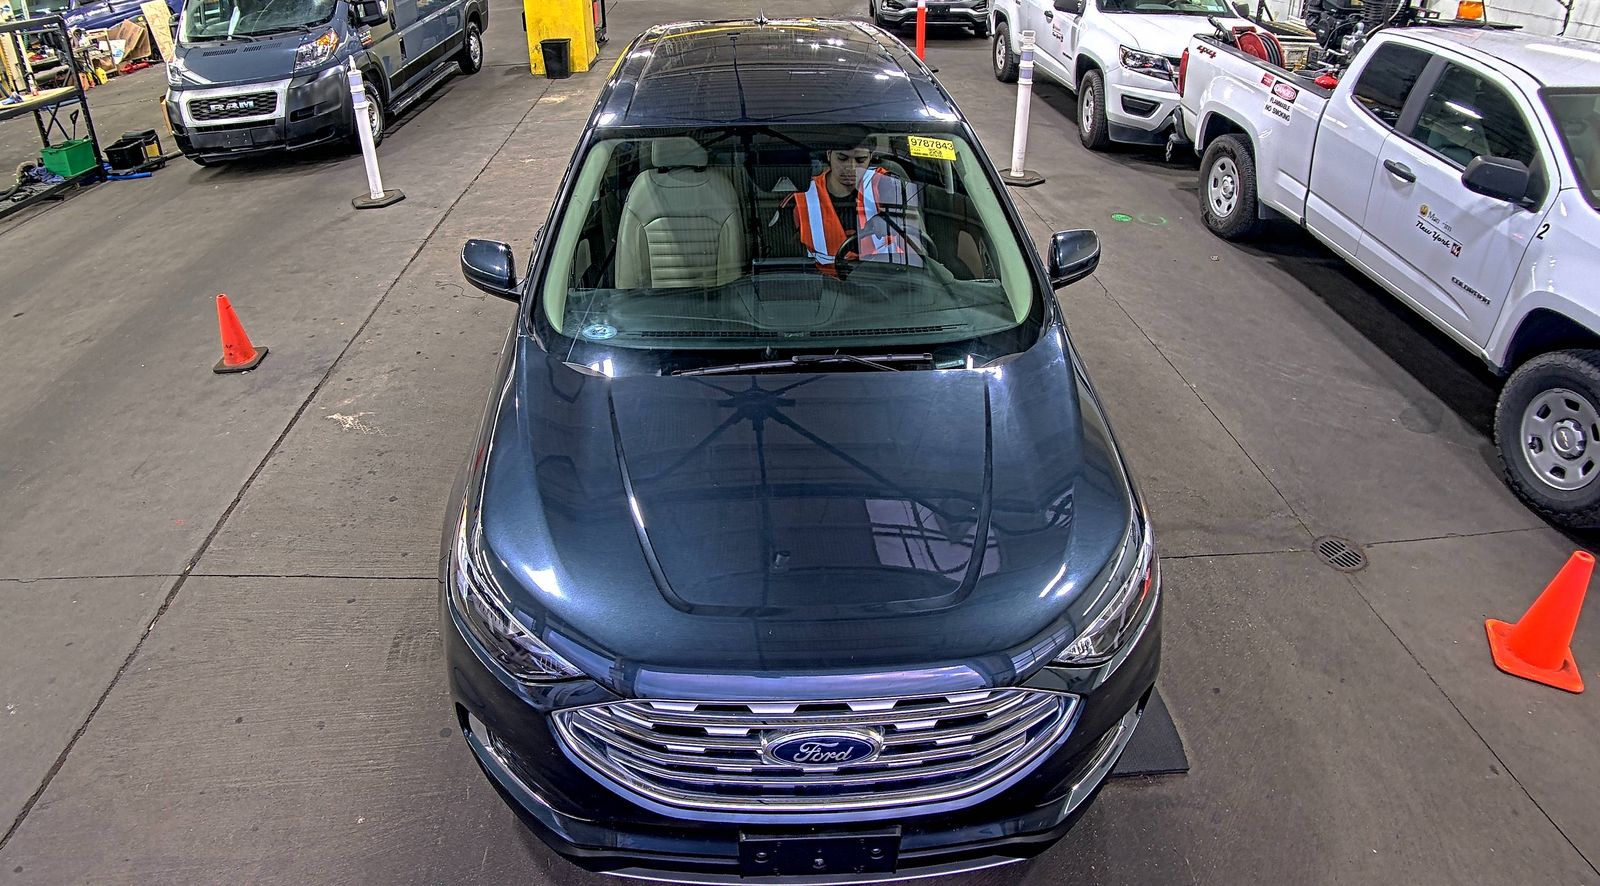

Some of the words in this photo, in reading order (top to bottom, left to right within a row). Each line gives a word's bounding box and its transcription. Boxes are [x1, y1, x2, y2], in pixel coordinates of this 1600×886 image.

[210, 101, 254, 112] RAM
[1270, 97, 1290, 111] FLAMMABLE
[1272, 108, 1290, 121] SMOKING
[911, 138, 954, 150] 9787843
[1416, 220, 1432, 234] New
[1432, 231, 1450, 248] York
[1537, 223, 1550, 240] 2
[793, 742, 854, 761] Ford
